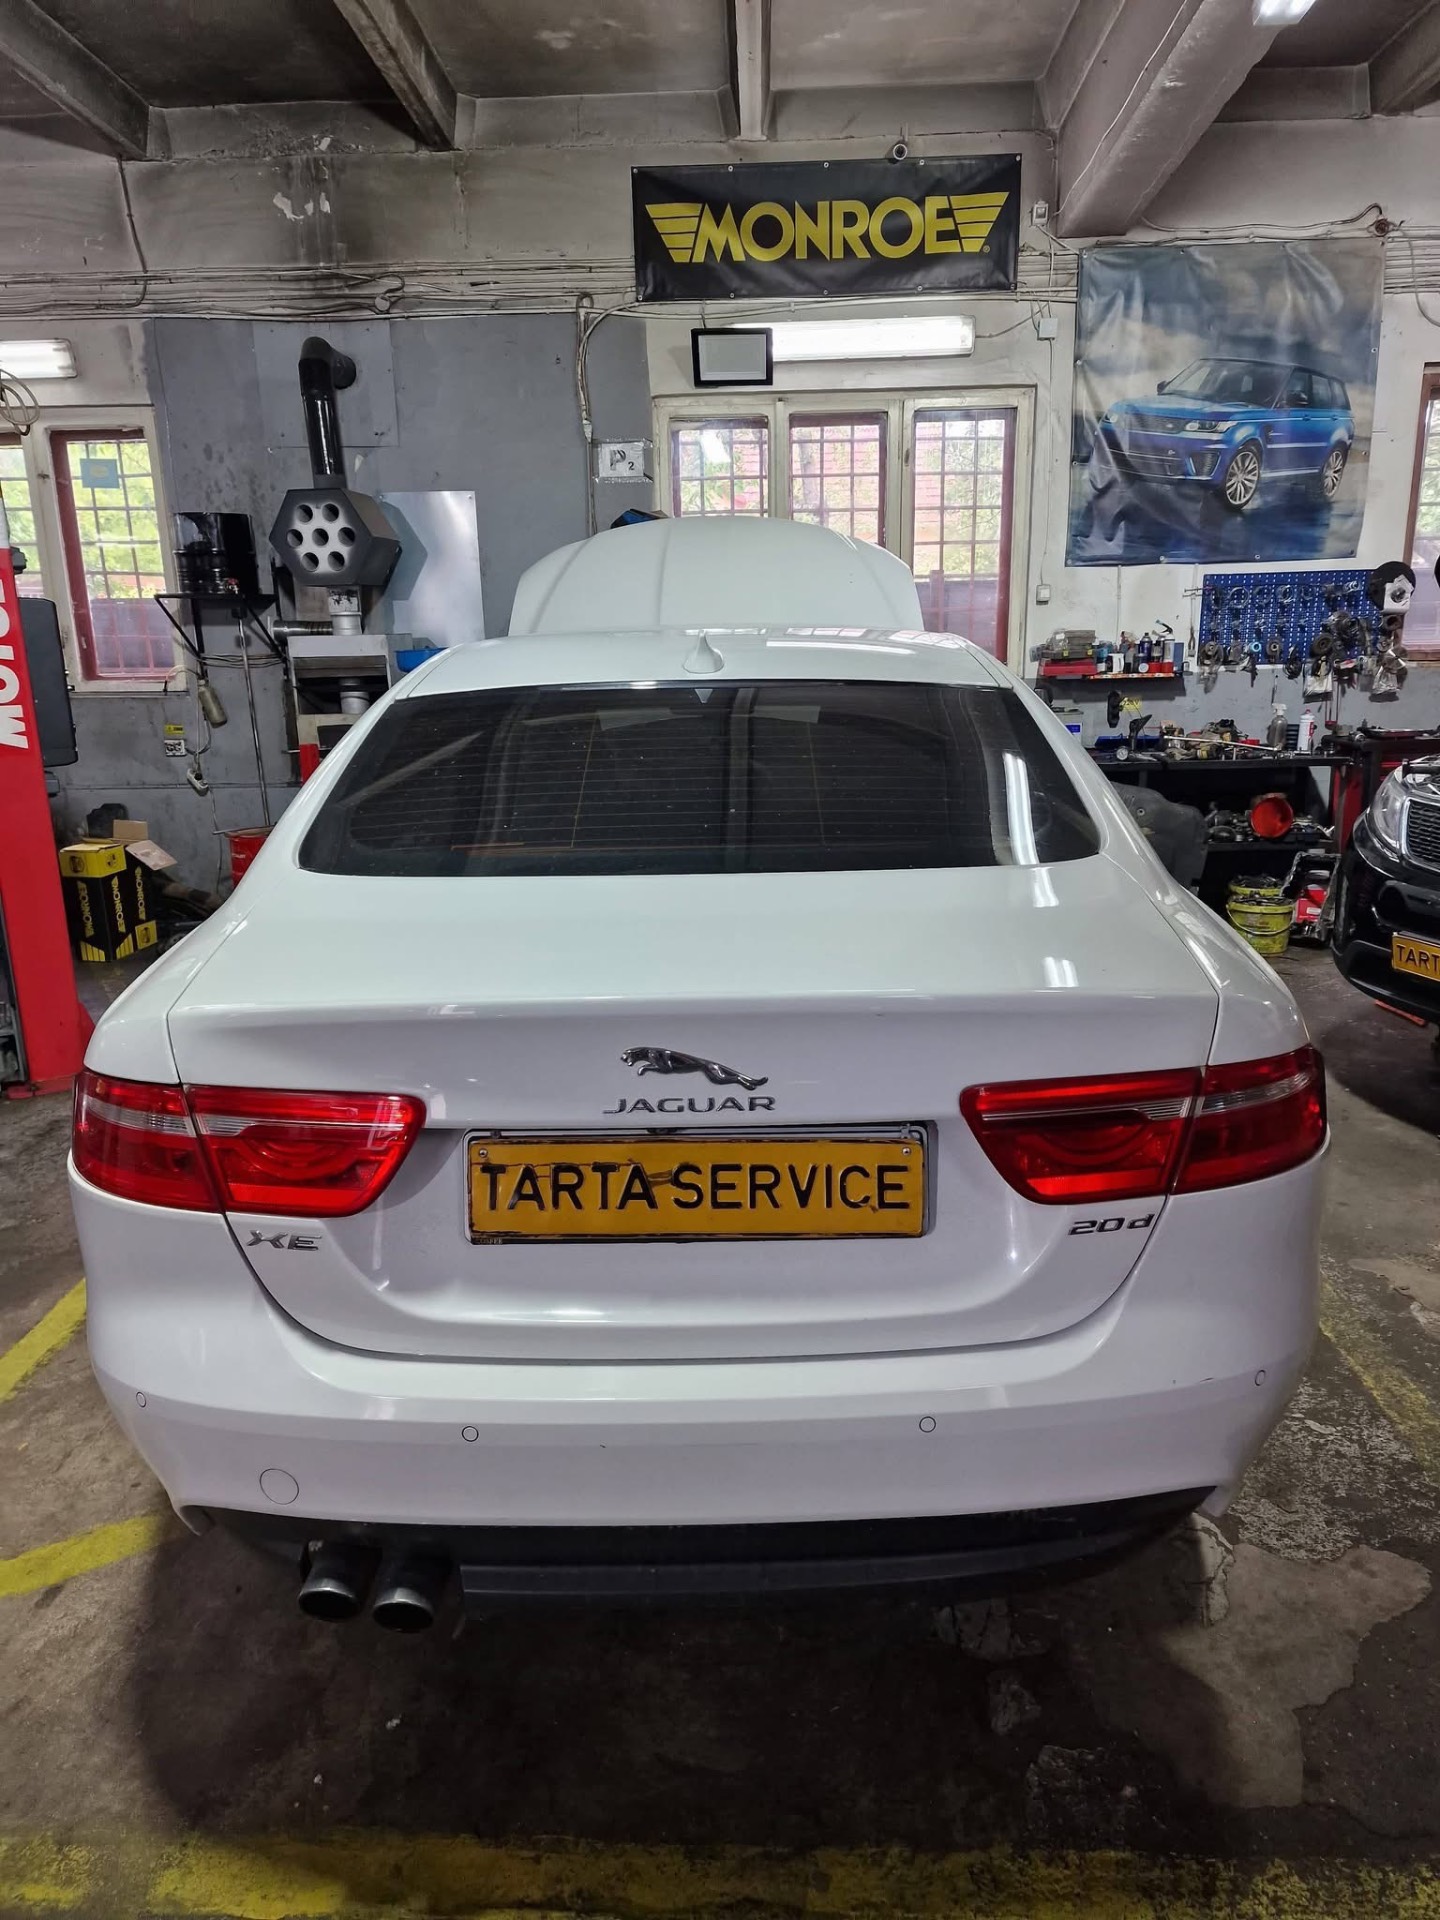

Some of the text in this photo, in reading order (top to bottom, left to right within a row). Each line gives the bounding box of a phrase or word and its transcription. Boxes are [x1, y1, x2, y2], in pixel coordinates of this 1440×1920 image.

[692, 196, 961, 263] MONROE
[603, 1096, 775, 1115] JAGUAR
[479, 1162, 910, 1211] TARTA SERVICE
[246, 1229, 322, 1252] XE
